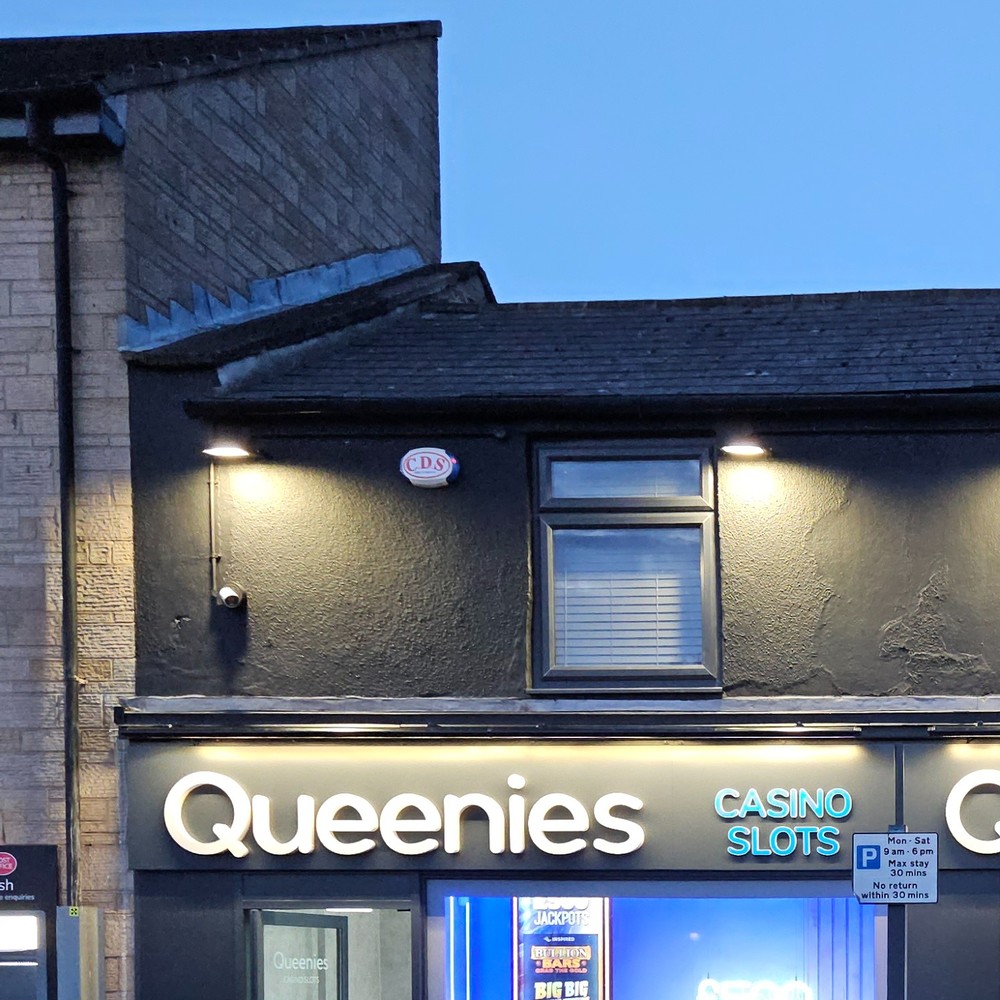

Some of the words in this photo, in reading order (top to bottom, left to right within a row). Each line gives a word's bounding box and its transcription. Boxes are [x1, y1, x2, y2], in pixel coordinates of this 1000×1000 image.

[714, 788, 852, 818] CASINO
[163, 770, 646, 858] Queenies
[727, 826, 840, 856] SLOTS
[888, 837, 907, 845] Mon
[914, 837, 931, 845] Sat
[862, 848, 877, 868] P
[888, 860, 907, 868] Max
[910, 860, 930, 869] stay
[890, 869, 904, 877] 30
[905, 869, 927, 877] mins
[873, 882, 886, 890] No
[889, 882, 918, 890] return
[861, 891, 890, 899] within
[907, 891, 929, 899] mins
[533, 911, 590, 926] JACKPOTS
[534, 948, 587, 959] BULLION
[273, 951, 329, 971] Queenies
[542, 959, 580, 968] BARS
[534, 981, 563, 999] BIG
[564, 980, 589, 997] BIG
